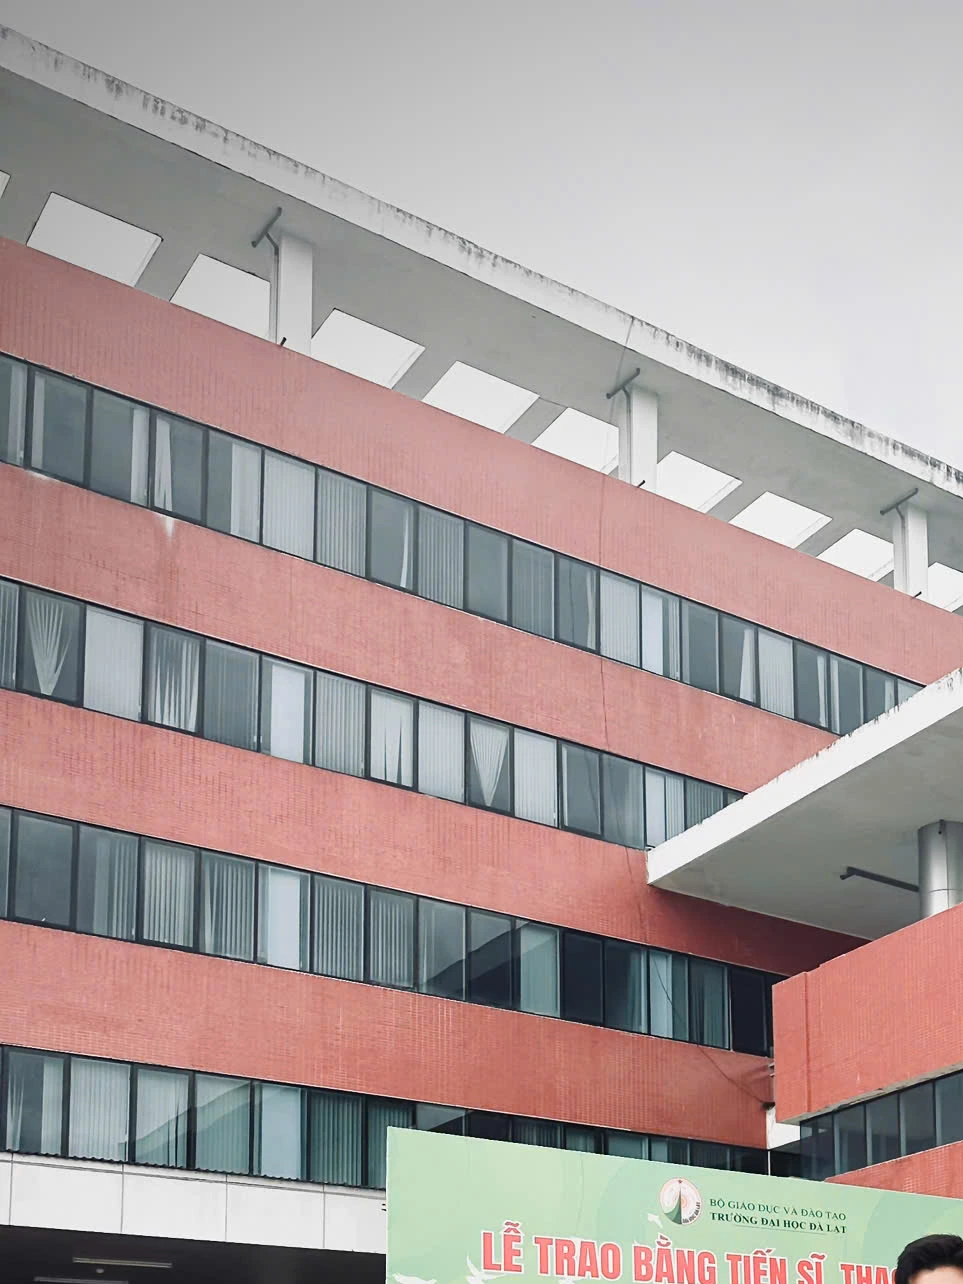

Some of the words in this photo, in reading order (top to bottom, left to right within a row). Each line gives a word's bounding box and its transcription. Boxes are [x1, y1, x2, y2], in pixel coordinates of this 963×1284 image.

[709, 1198, 725, 1209] BỘ
[710, 1212, 758, 1225] TRƯỜNG
[761, 1217, 780, 1228] ĐẠI
[783, 1219, 806, 1230] HỌC
[809, 1221, 824, 1232] ĐÀ
[481, 1220, 523, 1273] LỄ
[533, 1235, 622, 1280] TRAO
